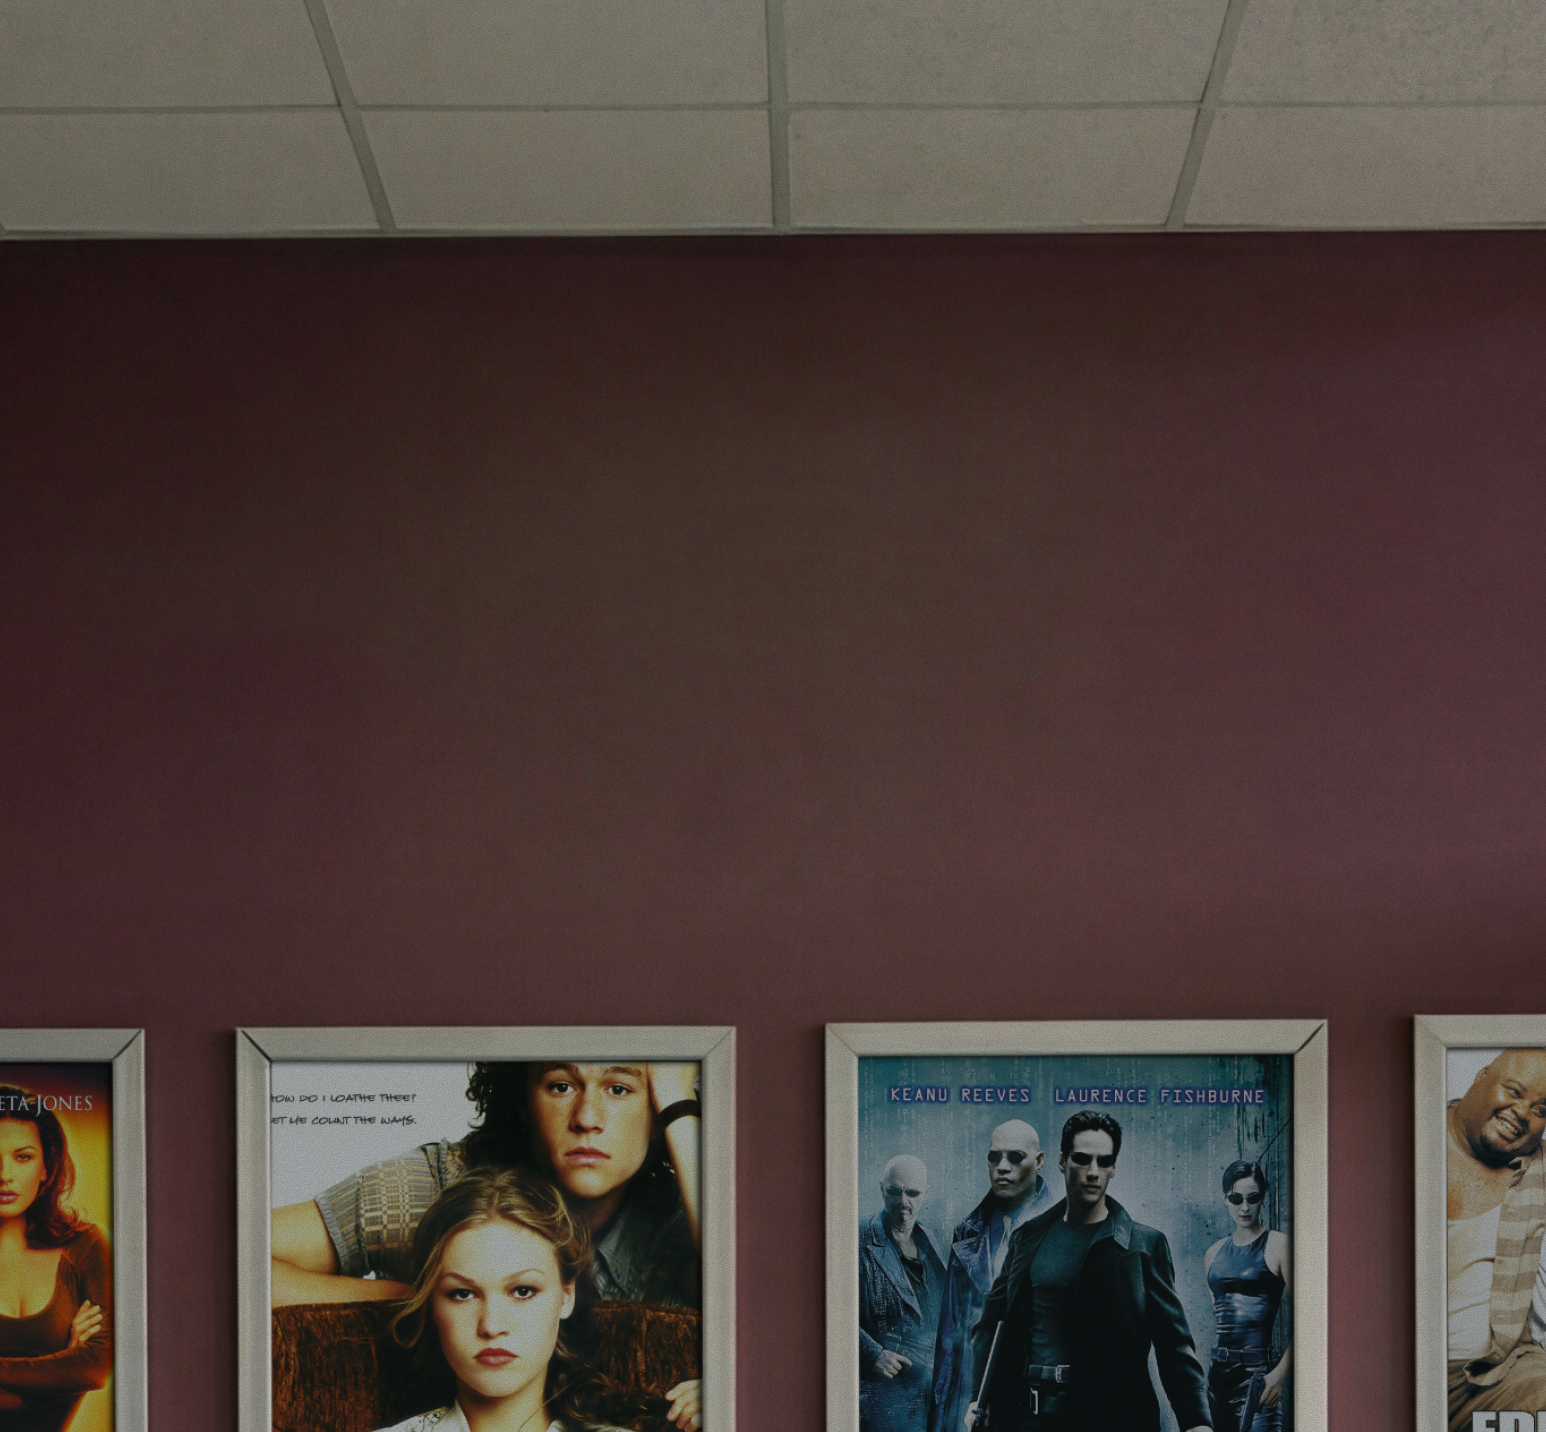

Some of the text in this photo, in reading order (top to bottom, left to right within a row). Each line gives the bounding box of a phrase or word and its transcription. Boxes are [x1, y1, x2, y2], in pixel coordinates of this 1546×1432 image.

[300, 1093, 317, 1104] DO
[321, 1094, 326, 1103] I
[330, 1092, 375, 1104] LOATHE
[378, 1092, 416, 1104] THEE?
[891, 1088, 1031, 1102] KEANU REEVES
[1055, 1088, 1265, 1103] LAURENCE FISHBURNE
[271, 1114, 417, 1127] ET ME COUNT THE WAYS.
